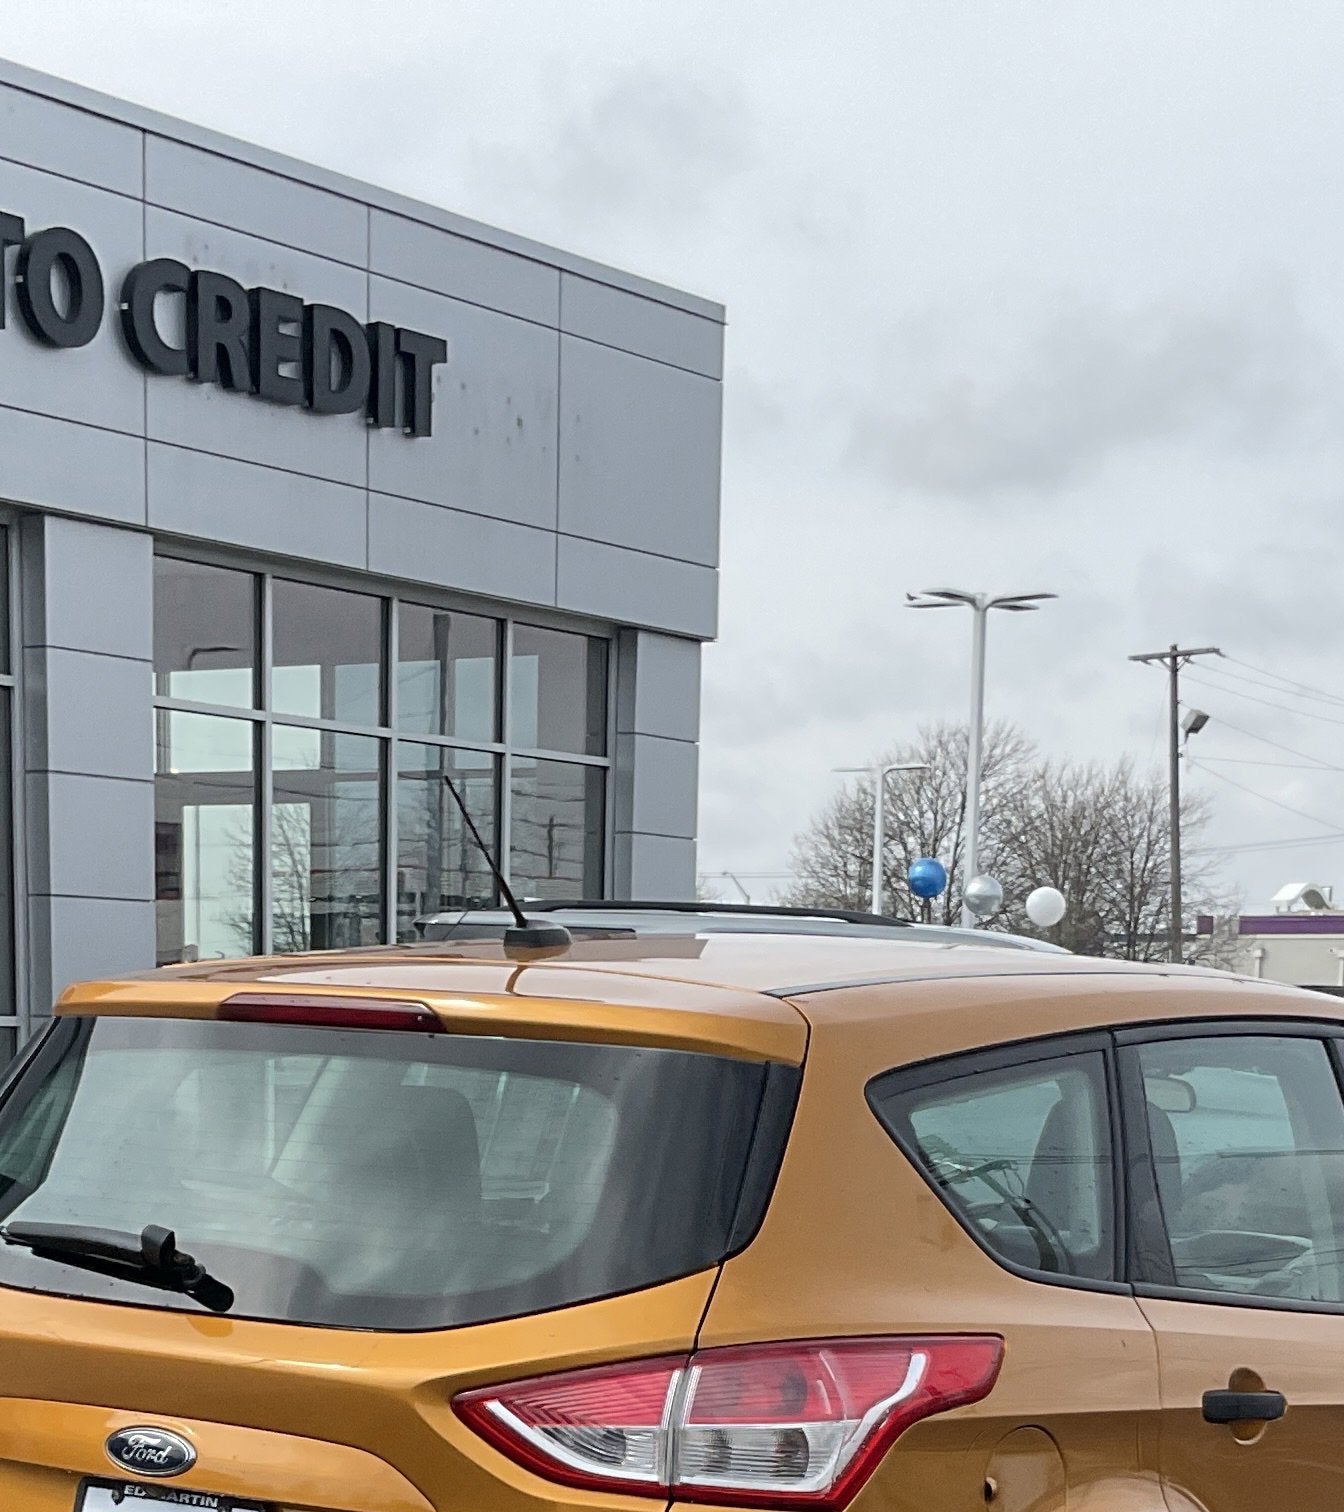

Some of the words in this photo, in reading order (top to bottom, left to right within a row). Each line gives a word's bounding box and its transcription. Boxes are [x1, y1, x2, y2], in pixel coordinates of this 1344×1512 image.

[121, 258, 448, 438] CREDIT
[121, 1433, 172, 1465] Ford
[123, 1484, 147, 1498] ED
[159, 1492, 219, 1508] ARTIN
